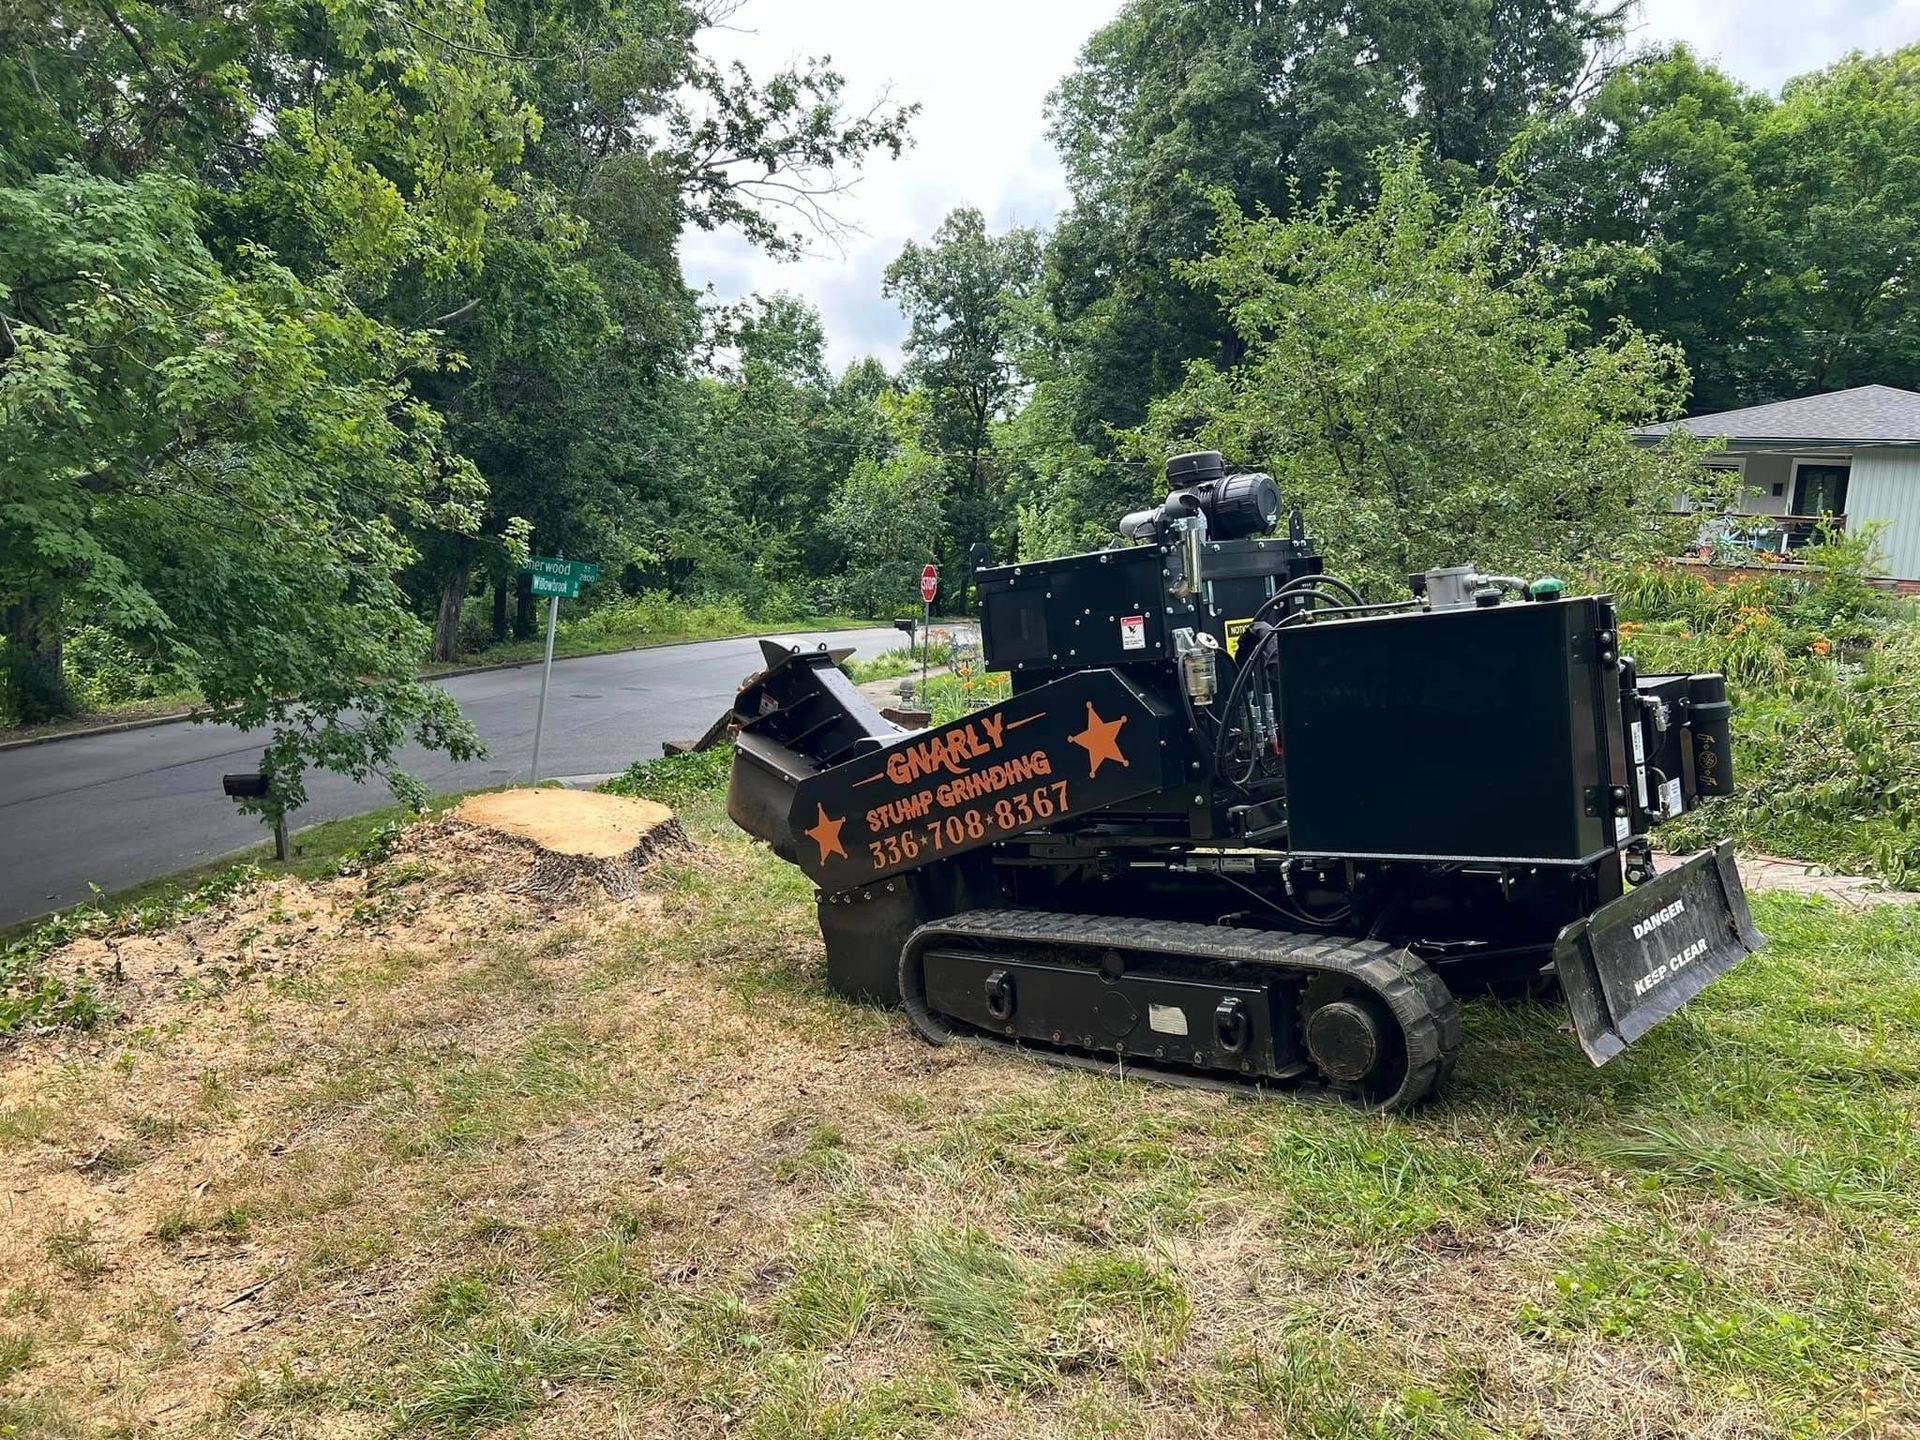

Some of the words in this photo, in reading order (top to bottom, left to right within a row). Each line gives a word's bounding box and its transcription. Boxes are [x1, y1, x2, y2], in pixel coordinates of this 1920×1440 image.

[533, 574, 567, 593] Willowbrook
[922, 576, 936, 590] STOP
[886, 712, 1004, 785] GNARLY
[865, 790, 933, 832] STUMP
[936, 750, 1052, 808] GRINDING
[1632, 899, 1685, 940] DANGER
[1633, 965, 1667, 997] KEEP
[1669, 938, 1708, 972] CLEAR
